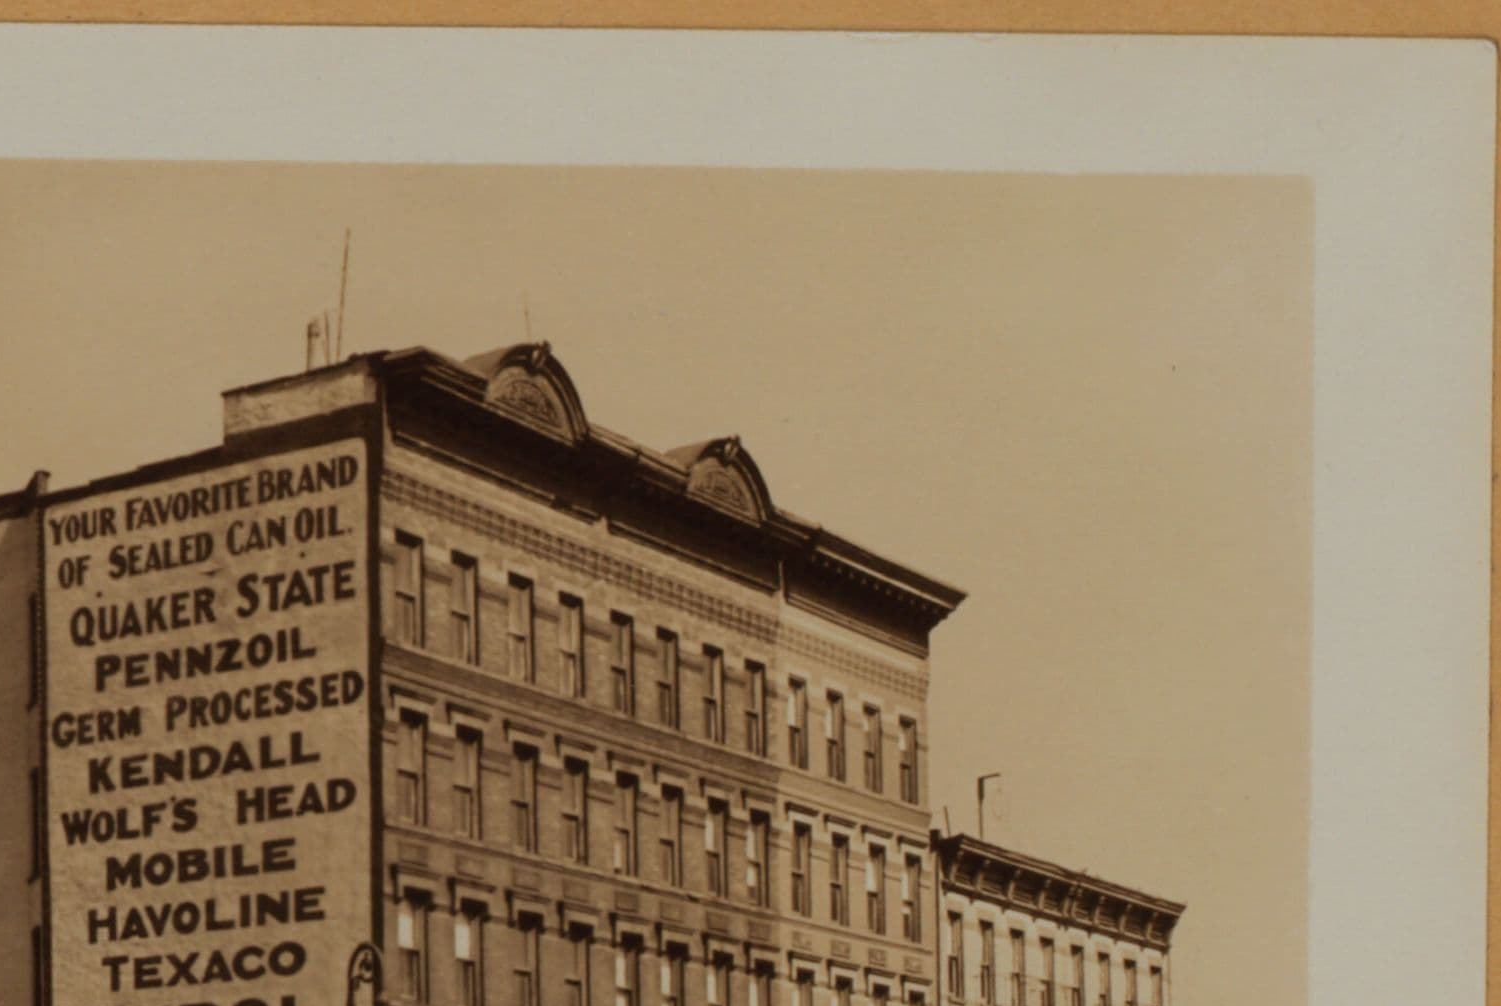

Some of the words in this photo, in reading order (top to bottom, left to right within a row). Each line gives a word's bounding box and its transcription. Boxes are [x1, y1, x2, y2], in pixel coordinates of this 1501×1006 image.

[49, 507, 116, 546] YOUR
[126, 476, 253, 531] FAVORITE
[258, 455, 358, 503] BRAND
[58, 555, 91, 589] OF
[108, 532, 213, 579] SEALED
[227, 516, 286, 555] CAN
[70, 587, 216, 647] QUAKER
[236, 561, 356, 618] STATE
[95, 627, 316, 692] PENNZOIL
[52, 706, 142, 748] GERM
[166, 670, 364, 732] PROCESSED
[88, 732, 320, 794] KENDALL
[61, 797, 197, 845] WOLF'S
[237, 779, 356, 824] HEAD
[106, 839, 296, 891] MOBILE
[88, 887, 325, 944] HAVOLINE
[102, 942, 306, 992] TEXACO
